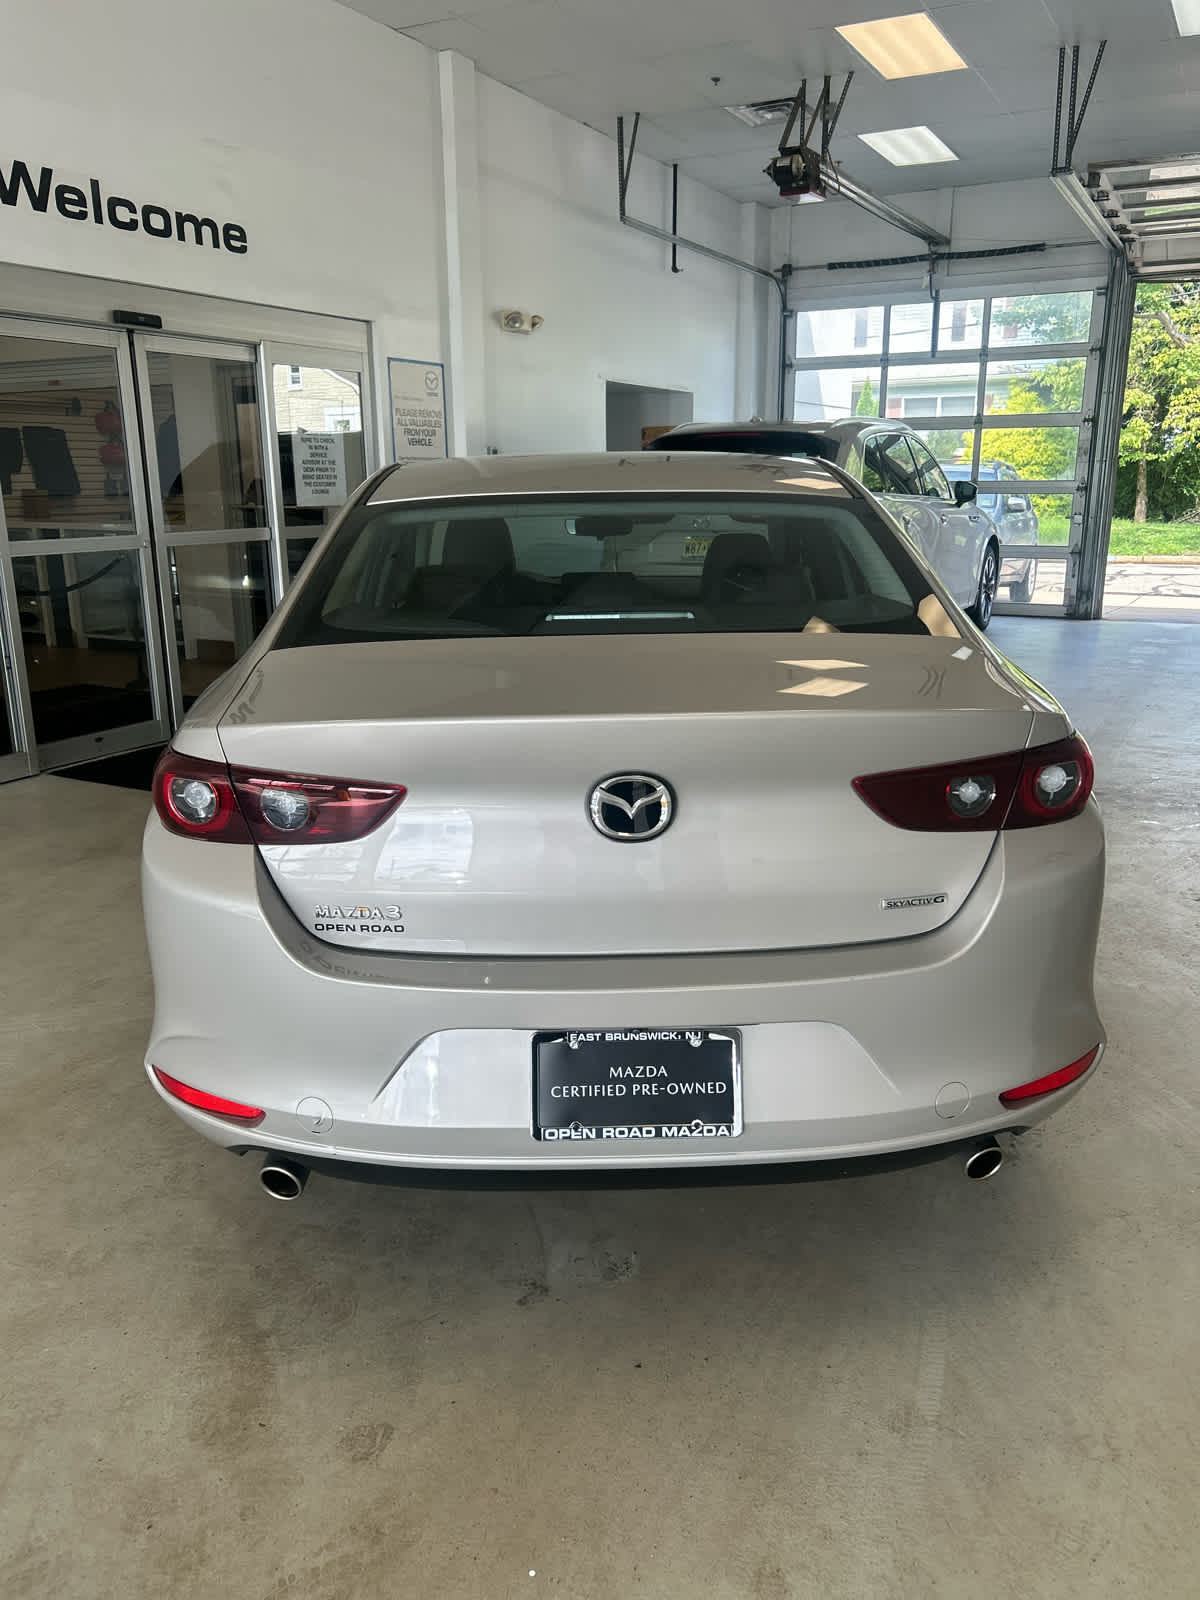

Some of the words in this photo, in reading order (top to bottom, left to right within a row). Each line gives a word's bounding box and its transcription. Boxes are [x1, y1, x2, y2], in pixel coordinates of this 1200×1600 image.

[0, 159, 248, 254] Welcome
[395, 407, 417, 417] PLEASE
[397, 418, 408, 427] ALL
[408, 418, 442, 428] VALUABLES
[404, 428, 421, 437] FROM
[421, 429, 436, 438] YOUR
[314, 923, 356, 932] OPEN
[360, 924, 405, 933] ROAD
[569, 1032, 602, 1042] EAST
[686, 1031, 702, 1040] NJ
[609, 1065, 668, 1079] MAZDA
[550, 1084, 626, 1098] CERTIFIED
[632, 1081, 728, 1096] PRE-OWNED
[544, 1127, 596, 1141] OPEN
[602, 1126, 656, 1139] ROAD
[661, 1124, 731, 1138] MAZDA
